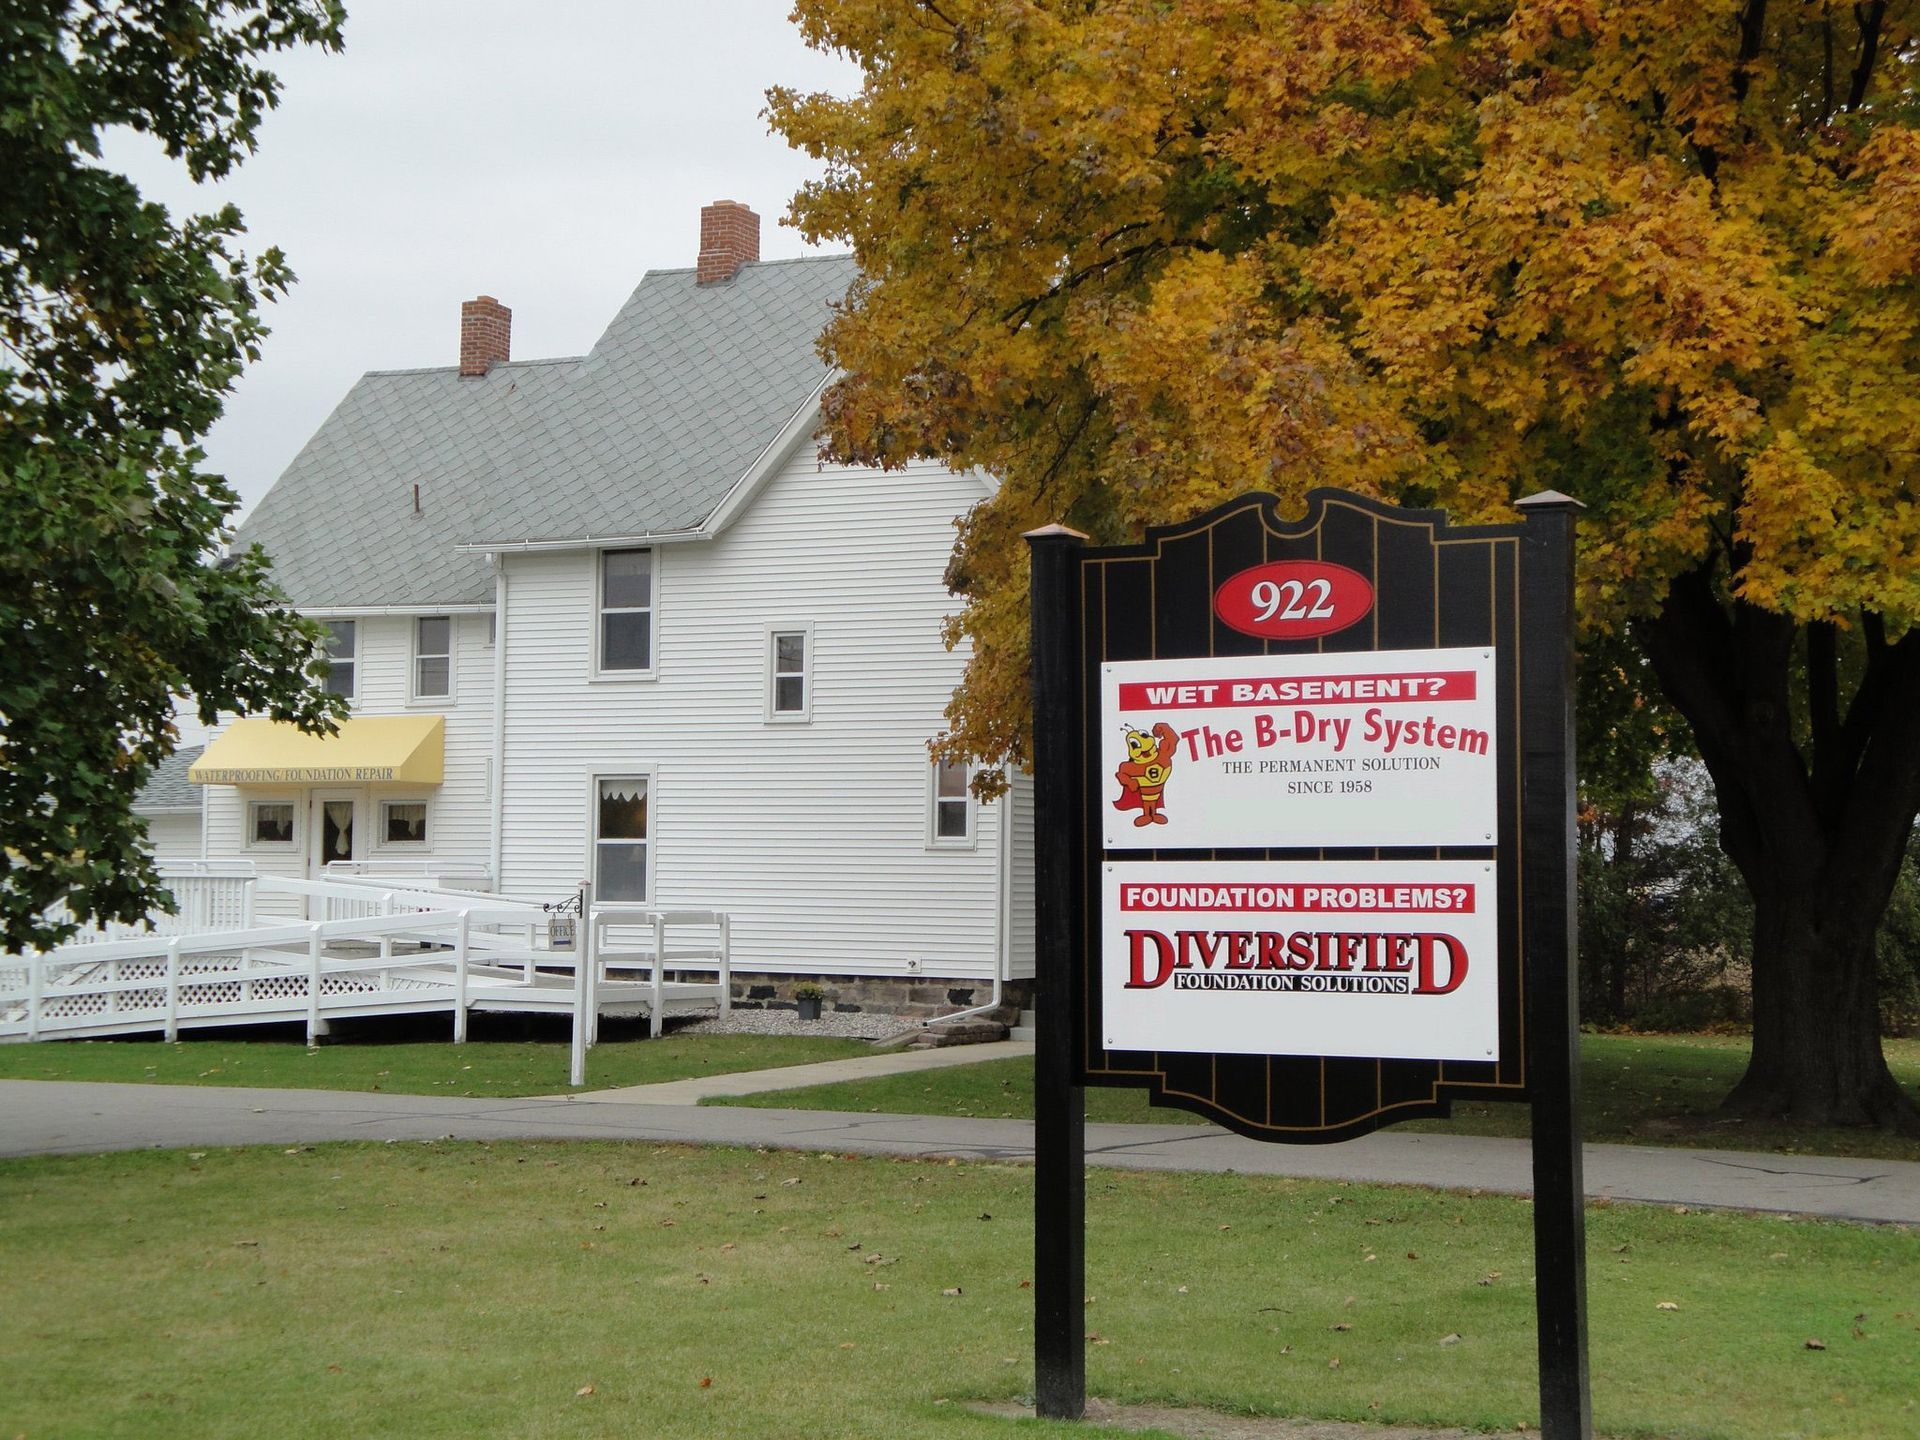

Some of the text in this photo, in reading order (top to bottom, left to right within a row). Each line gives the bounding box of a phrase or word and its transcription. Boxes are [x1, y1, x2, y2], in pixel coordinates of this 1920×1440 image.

[1251, 578, 1336, 622] 922
[1145, 678, 1447, 705] WET BASEMENT?
[1181, 708, 1490, 763] The B-Dry System
[355, 767, 393, 780] REPAIR
[1222, 756, 1441, 775] THE PERMANENT SOLUTION
[1287, 780, 1373, 794] SINCE 1958
[1126, 887, 1468, 909] FOUNDATION PROBLEMS?
[550, 925, 576, 937] OFFICE
[1123, 929, 1469, 996] DIVERSIFIED
[1176, 973, 1408, 994] FOUNDATION SOLUTIONS
